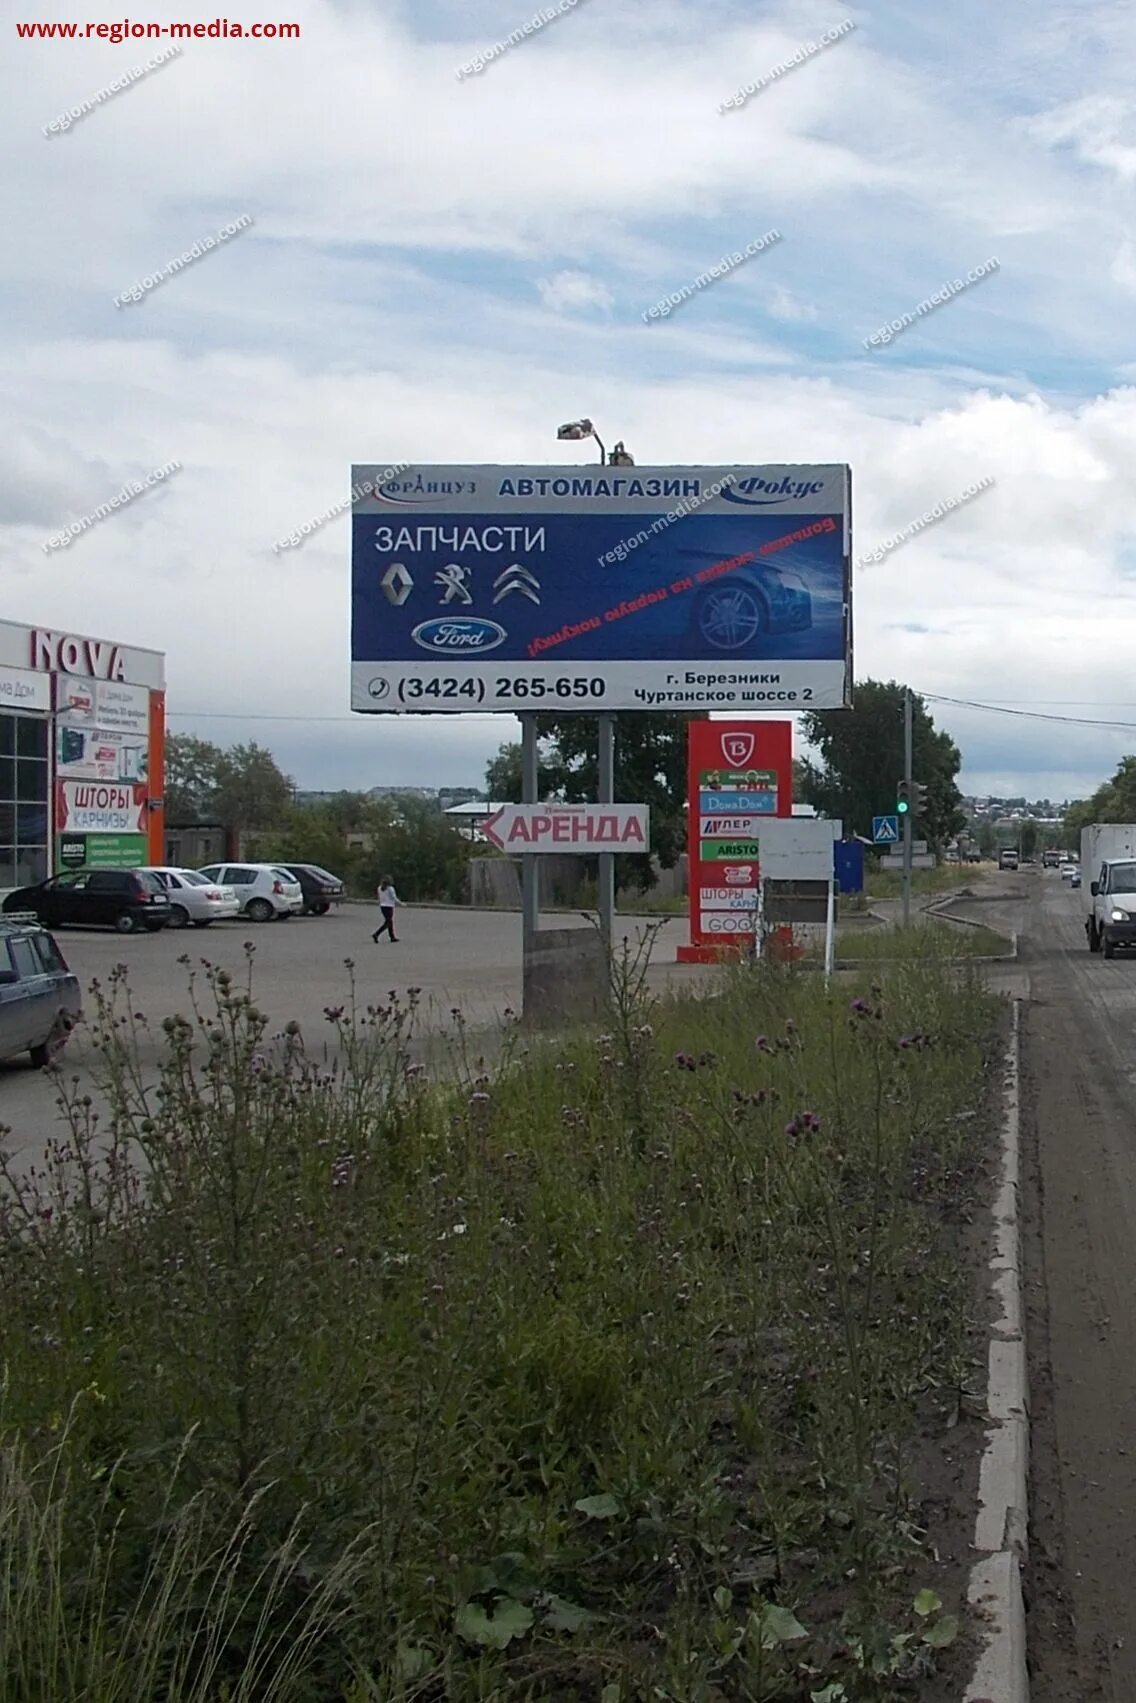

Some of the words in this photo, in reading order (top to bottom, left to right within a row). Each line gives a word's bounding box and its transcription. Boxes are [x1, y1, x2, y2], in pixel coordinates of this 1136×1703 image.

[499, 479, 699, 497] АВТОМАГАЗИН
[738, 476, 824, 499] Фокус
[375, 527, 545, 552] ЗАПЧАСТИ
[433, 625, 484, 645] Ford
[31, 629, 125, 682] NOVA
[398, 678, 485, 702] (3424)
[496, 678, 605, 697] 265-650
[666, 675, 679, 684] г.
[685, 672, 780, 687] Березники
[634, 689, 736, 704] Чуртанское
[742, 690, 797, 701] шоссе
[803, 689, 813, 700] 2
[75, 787, 129, 809] ШТОРЫ
[73, 811, 129, 828] КАРНИЗЫ
[507, 816, 645, 842] АРЕНДА
[702, 889, 743, 899] ШТОРЫ
